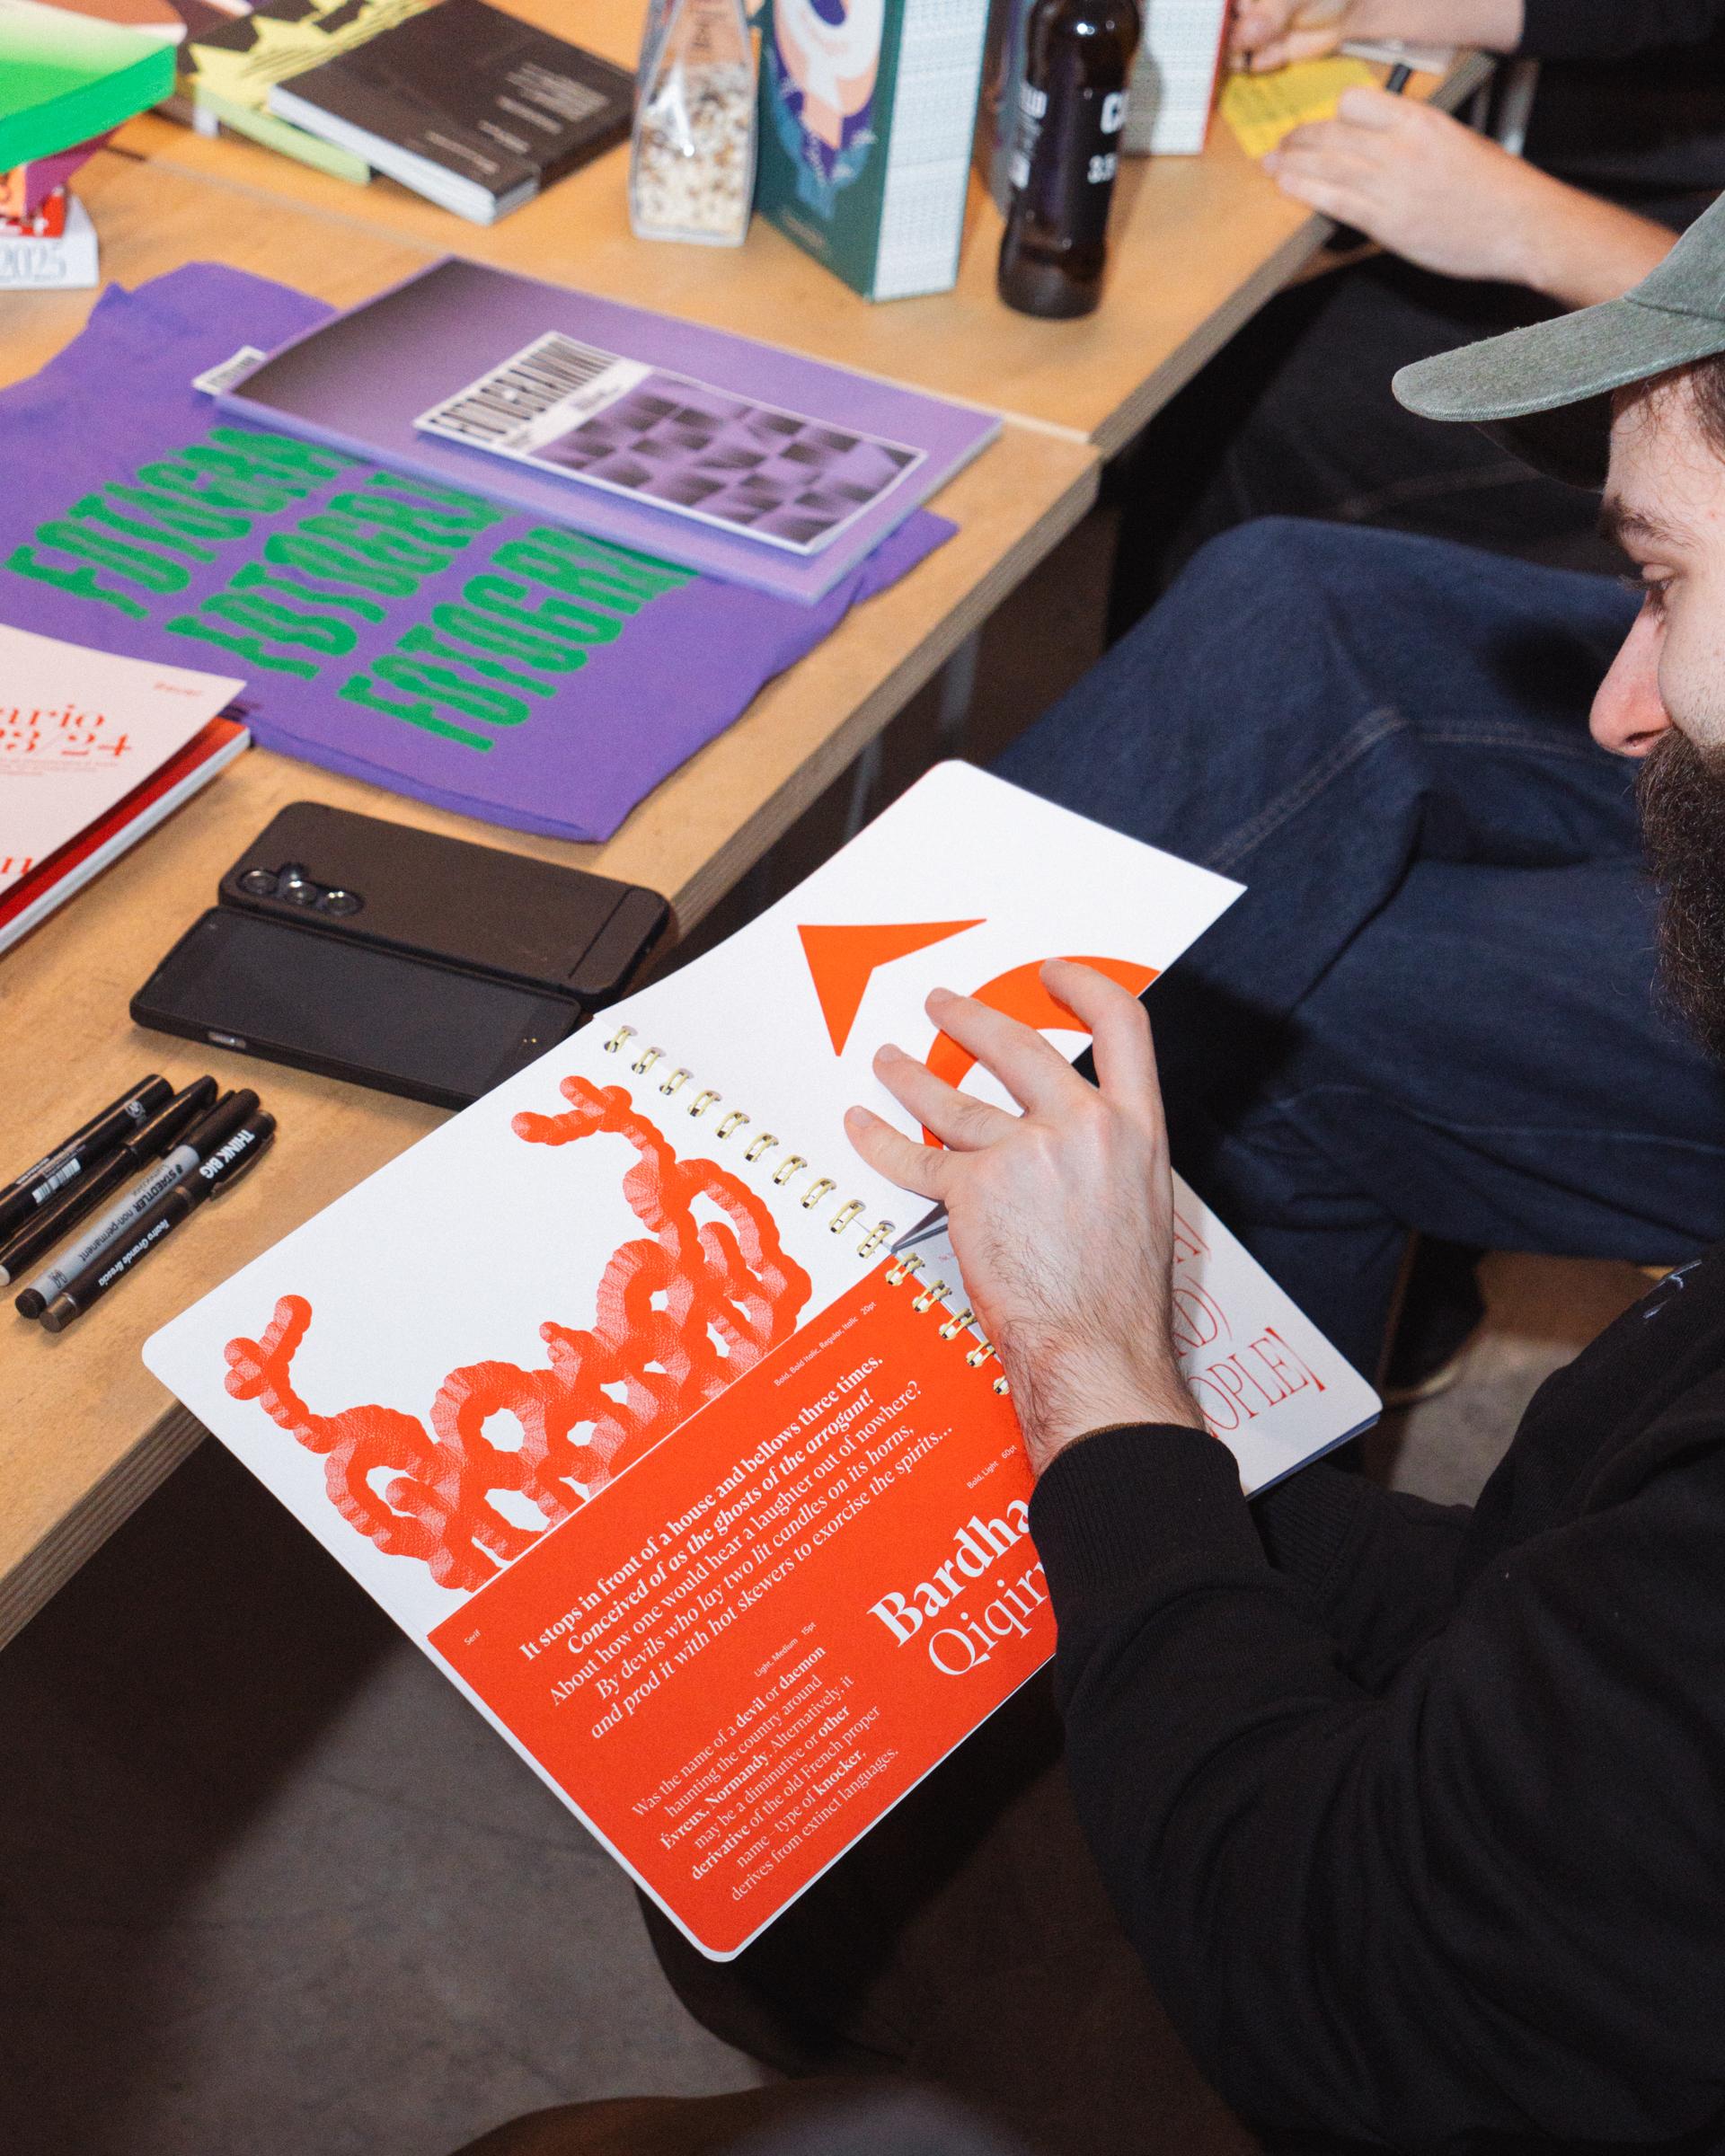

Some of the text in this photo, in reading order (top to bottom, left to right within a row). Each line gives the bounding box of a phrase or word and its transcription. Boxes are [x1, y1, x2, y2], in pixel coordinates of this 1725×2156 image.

[80, 1169, 179, 1261] STAEDTLER non-permanent
[199, 1128, 256, 1180] THINK BIG
[98, 1219, 171, 1287] Teatro Grande Brescia
[772, 1371, 793, 1388] Bold,
[788, 1358, 807, 1375] Bold
[818, 1328, 846, 1350] Regular,
[840, 1315, 860, 1331] Italic
[859, 1300, 878, 1316] 20pt
[518, 1356, 883, 1661] It stops in front of a house and bellows three times.
[568, 1387, 874, 1654] Conceived of as the ghosts of the arrogant!
[965, 1444, 1018, 1490] Bold, Light 60pt
[550, 1380, 922, 1706] About how one would hear a laughter out of nowhere?
[591, 1427, 952, 1739] and prod it with hot skewers to exorcise the spirits...
[595, 1425, 915, 1700] By devils who lay two lit candles on its horns,
[866, 1498, 1030, 1648] Bardha
[463, 1627, 482, 1647] Serif
[770, 1637, 800, 1663] Medium
[800, 1621, 818, 1637] 15pt
[928, 1560, 1048, 1676] Qiqir
[631, 1647, 827, 1816] Was the name of a devil or daemon
[659, 1675, 854, 1851] Évreux, Normandy. Alternatively, it
[664, 1674, 823, 1817] haunting the country around
[692, 1706, 880, 1880] derivative of the old French proper
[694, 1705, 850, 1849] may be a diminutive or other
[801, 1791, 816, 1808] of
[811, 1749, 866, 1797] knocker,
[731, 1748, 898, 1901] derives from extinct languages.
